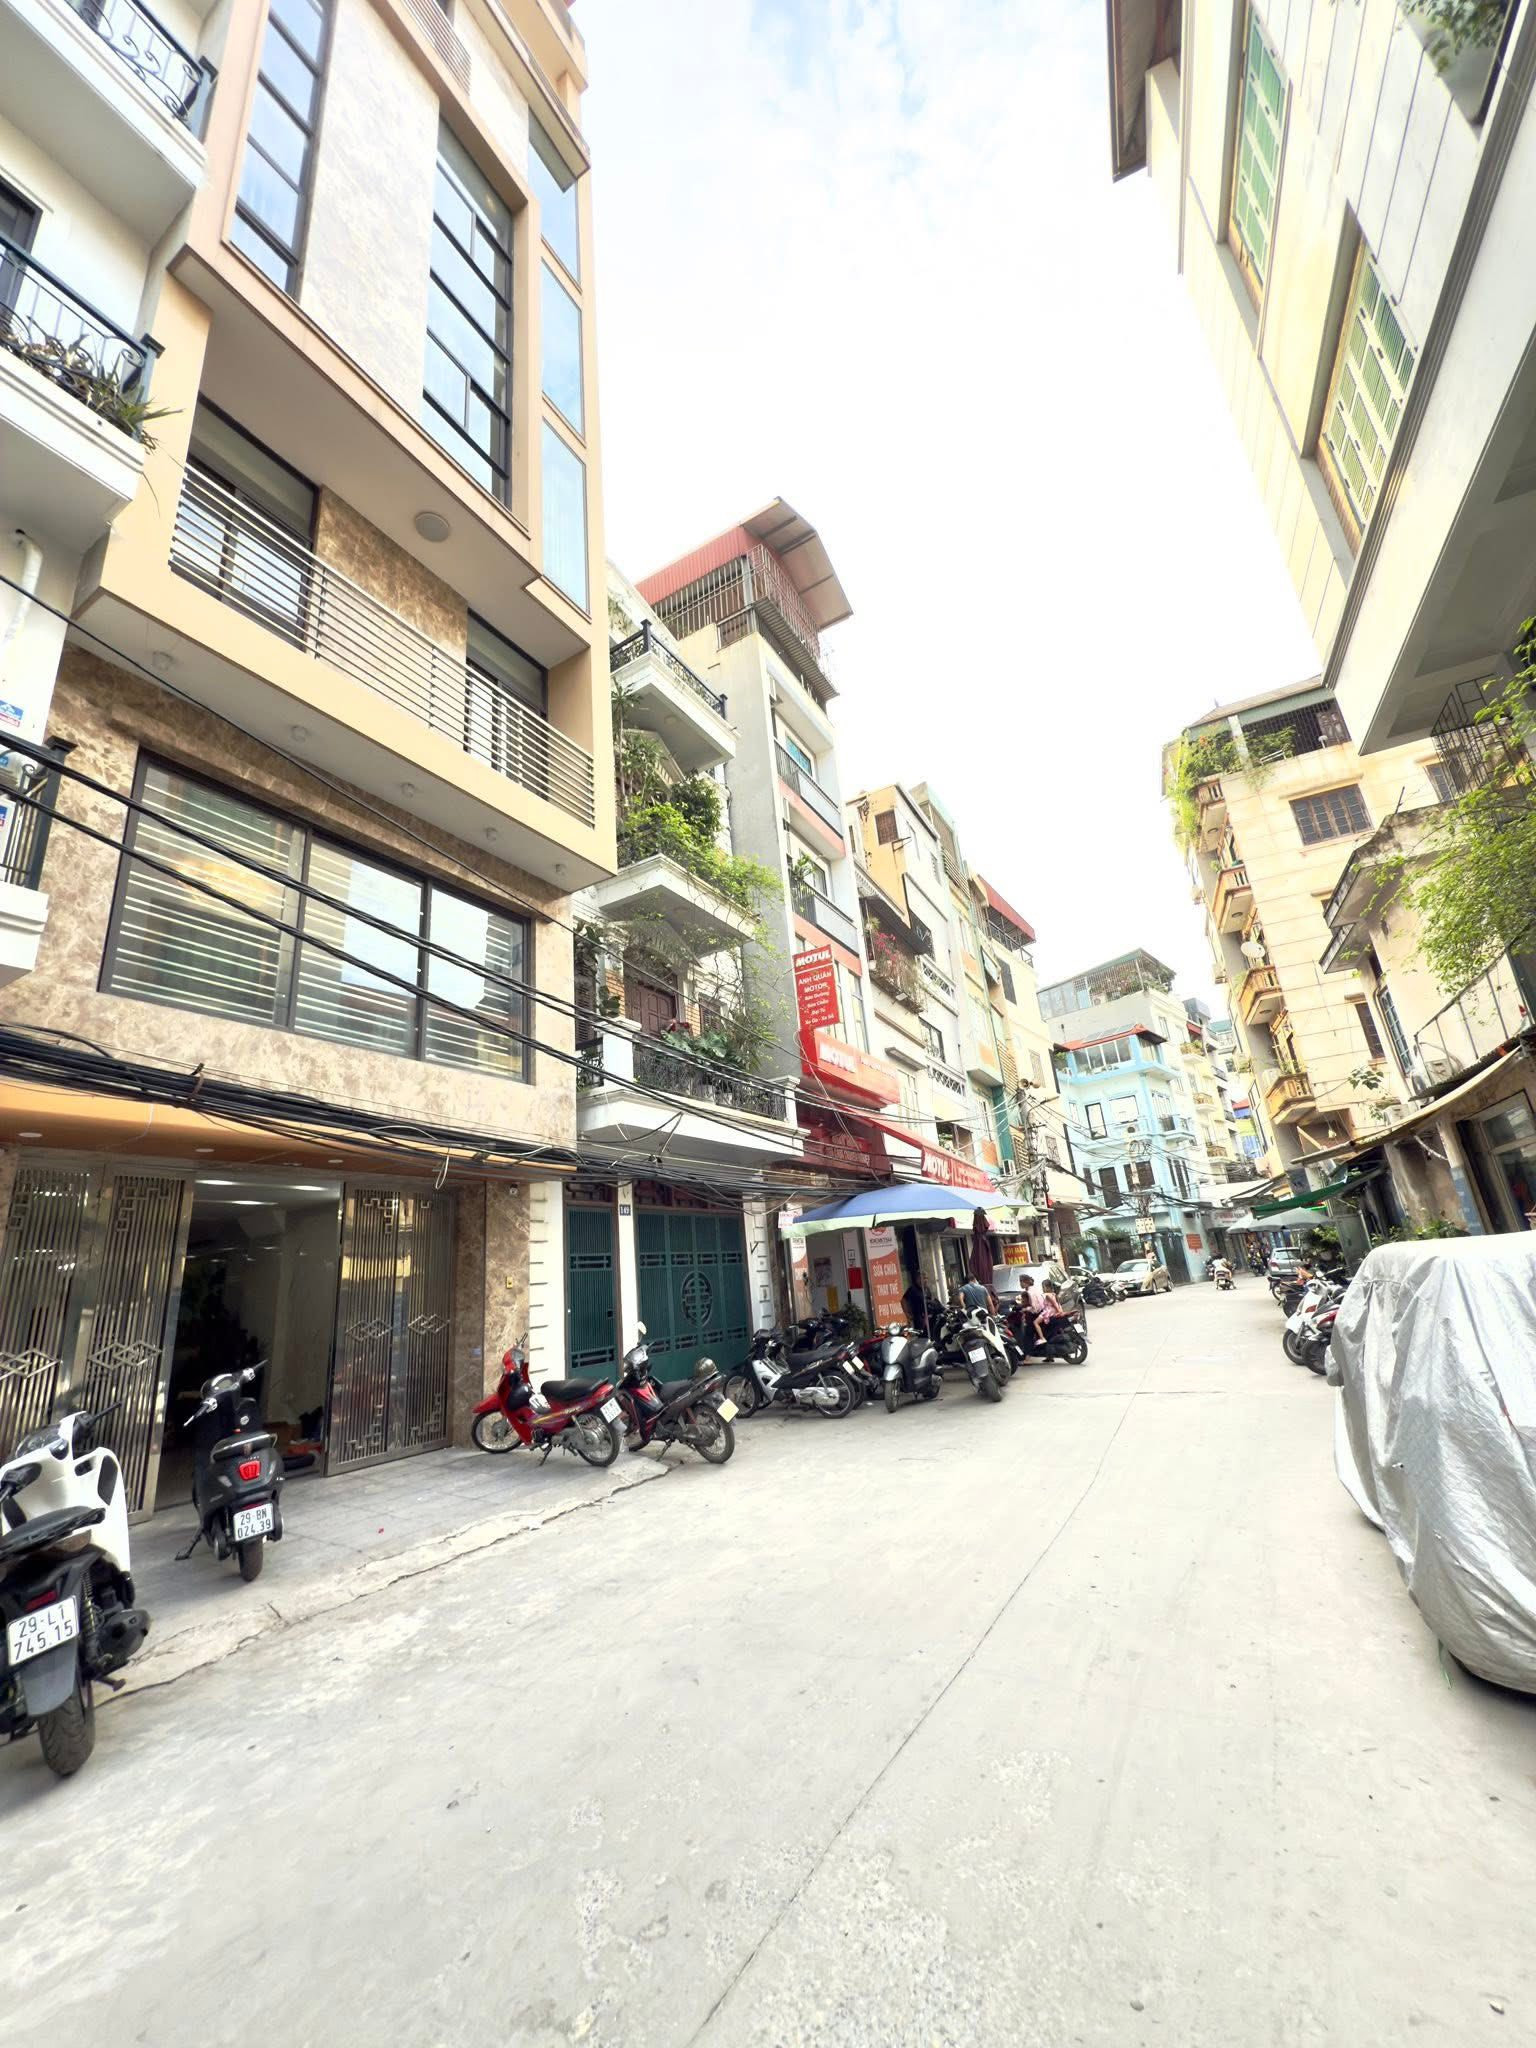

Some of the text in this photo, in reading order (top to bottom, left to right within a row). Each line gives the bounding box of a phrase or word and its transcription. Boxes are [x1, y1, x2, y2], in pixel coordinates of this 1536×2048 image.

[796, 950, 831, 967] MOTUL
[798, 976, 812, 985] ANH
[237, 1518, 271, 1538] 024.39
[19, 1604, 65, 1638] 29-L1
[14, 1620, 73, 1661] 745.15
